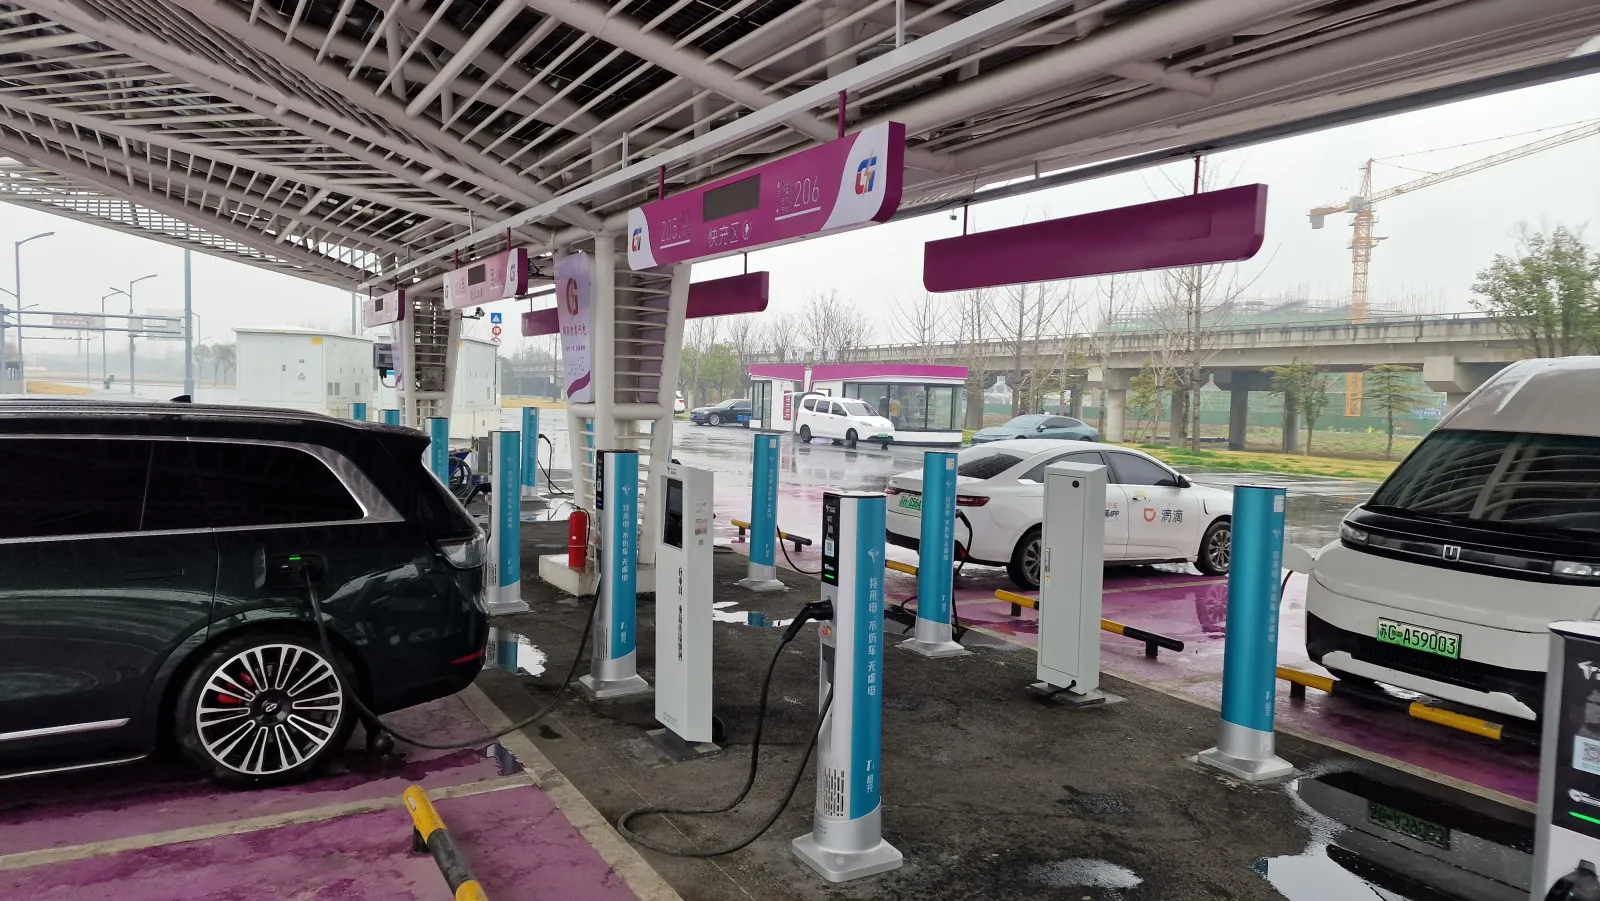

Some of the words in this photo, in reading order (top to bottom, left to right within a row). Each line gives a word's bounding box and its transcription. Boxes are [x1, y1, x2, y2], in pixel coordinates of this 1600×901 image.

[793, 176, 820, 207] 206
[708, 221, 739, 248] 快充区
[1161, 509, 1184, 524] 滴滴
[868, 576, 878, 614] 特来电
[867, 620, 877, 656] 不伤车
